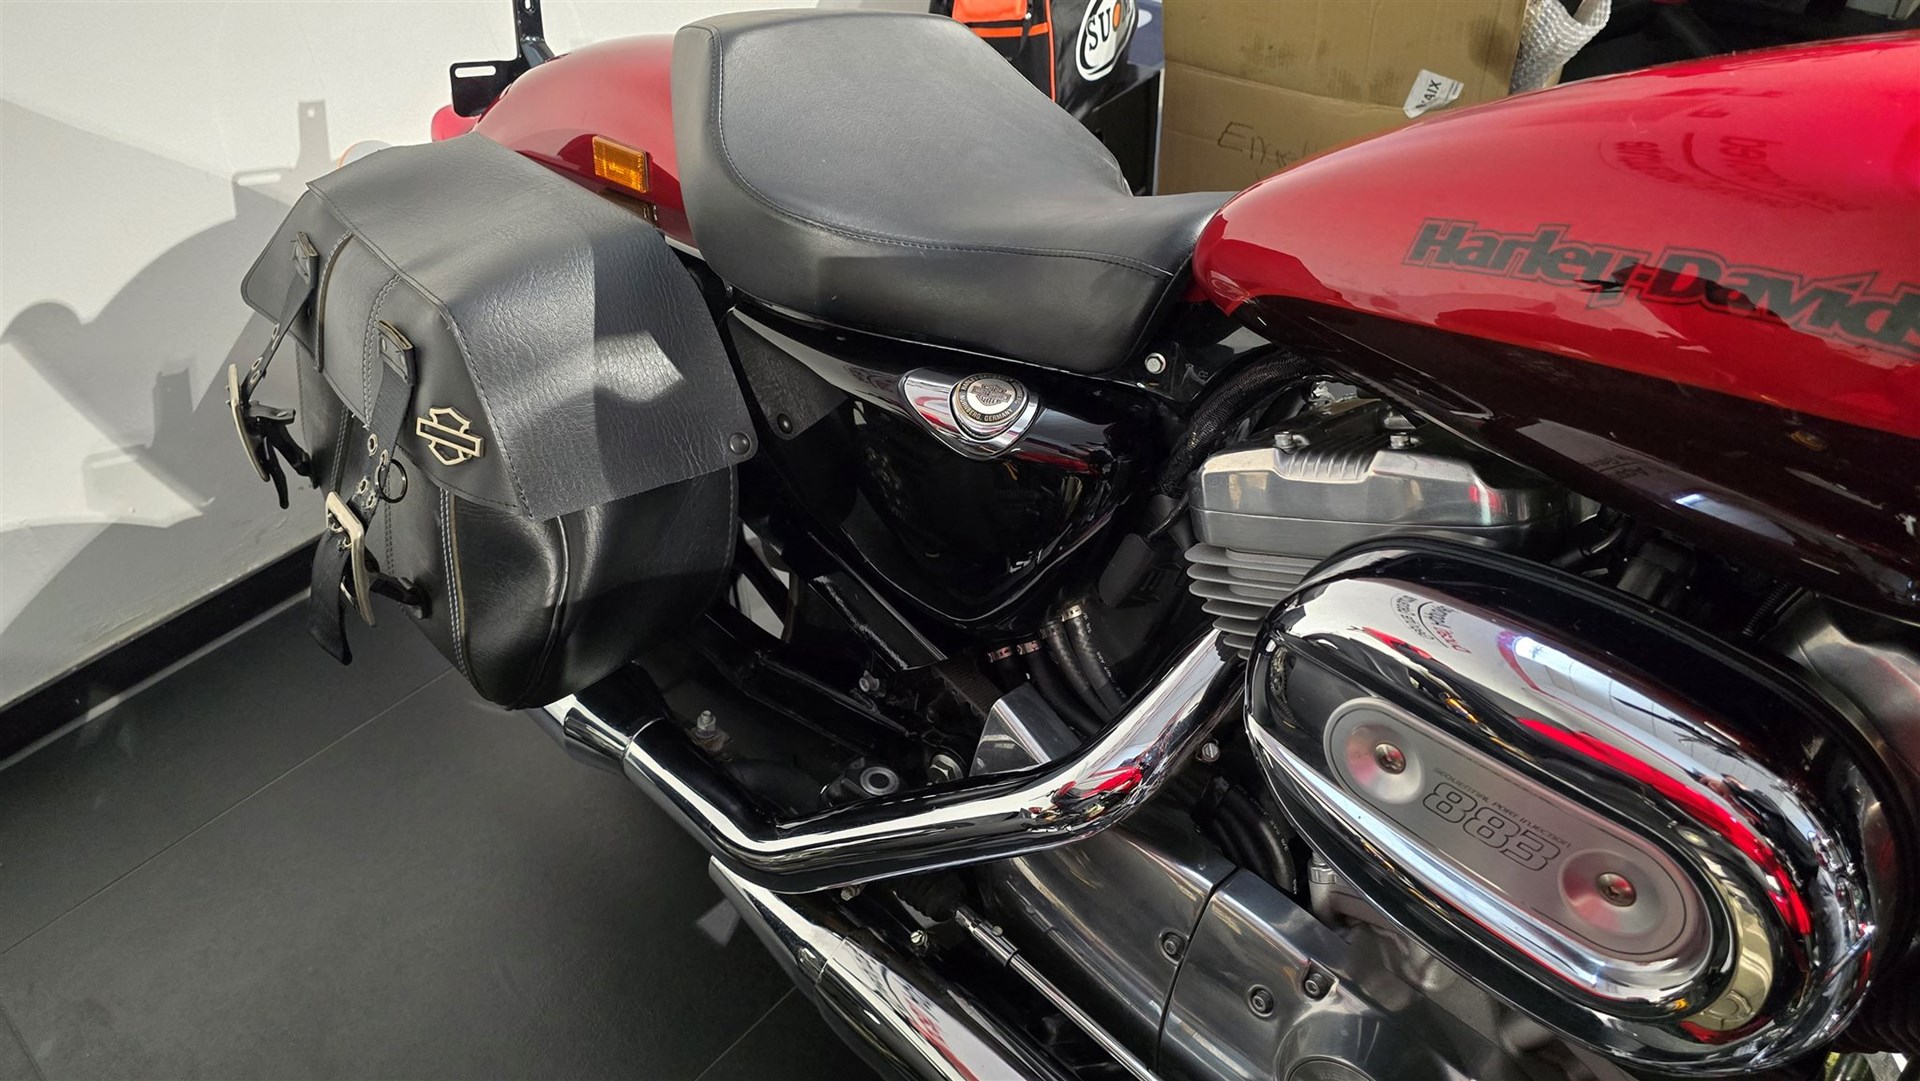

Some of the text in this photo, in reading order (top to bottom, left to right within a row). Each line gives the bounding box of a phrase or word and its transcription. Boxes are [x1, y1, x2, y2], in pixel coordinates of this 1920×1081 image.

[1402, 217, 1920, 362] Harley-David
[1423, 782, 1561, 871] 883
[1492, 801, 1519, 819] PORT
